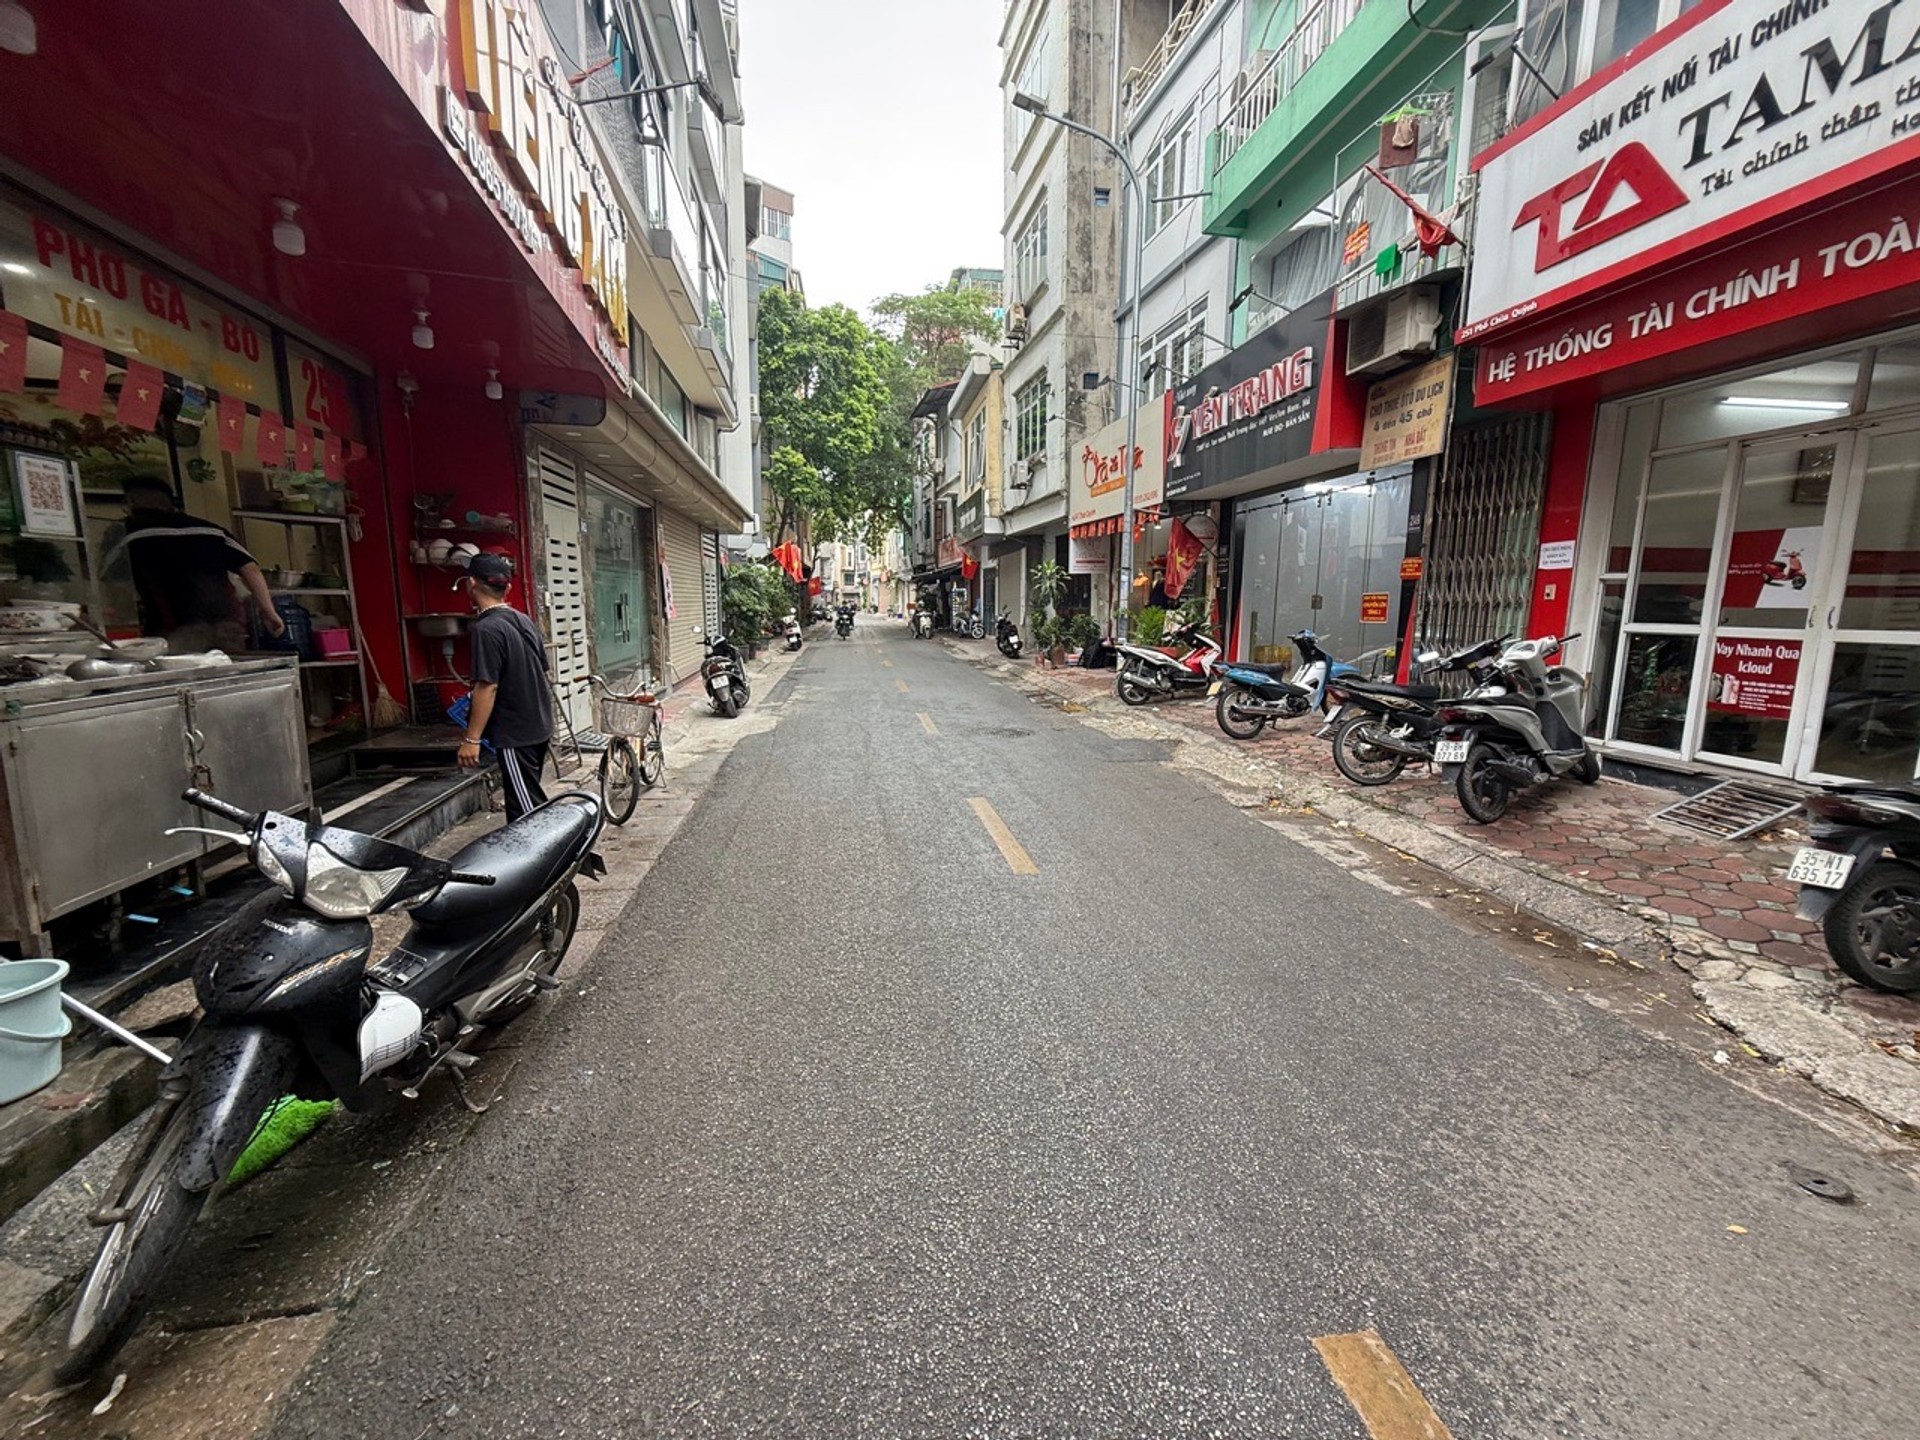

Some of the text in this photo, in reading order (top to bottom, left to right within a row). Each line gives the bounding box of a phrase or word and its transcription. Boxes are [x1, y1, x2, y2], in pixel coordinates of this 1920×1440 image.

[1577, 112, 1614, 152] SÀN
[1618, 84, 1656, 128] KẾT
[1708, 32, 1743, 75] TÀI
[1742, 131, 1809, 176] chính
[1821, 100, 1881, 141] thân
[1488, 352, 1517, 383] HỆ
[1524, 322, 1613, 372] THỐNG
[1627, 302, 1674, 339] TÀI
[1685, 268, 1800, 320] CHÍNH
[1818, 215, 1920, 278] TOÀ
[1229, 346, 1313, 422] TRANG
[1399, 409, 1413, 424] 45
[1716, 642, 1800, 660] Vay Nhanh Qua
[1738, 660, 1773, 675] Icloud
[1801, 851, 1843, 870] 35-N1
[1790, 865, 1844, 886] 635.17
[261, 918, 294, 936] HONDA
